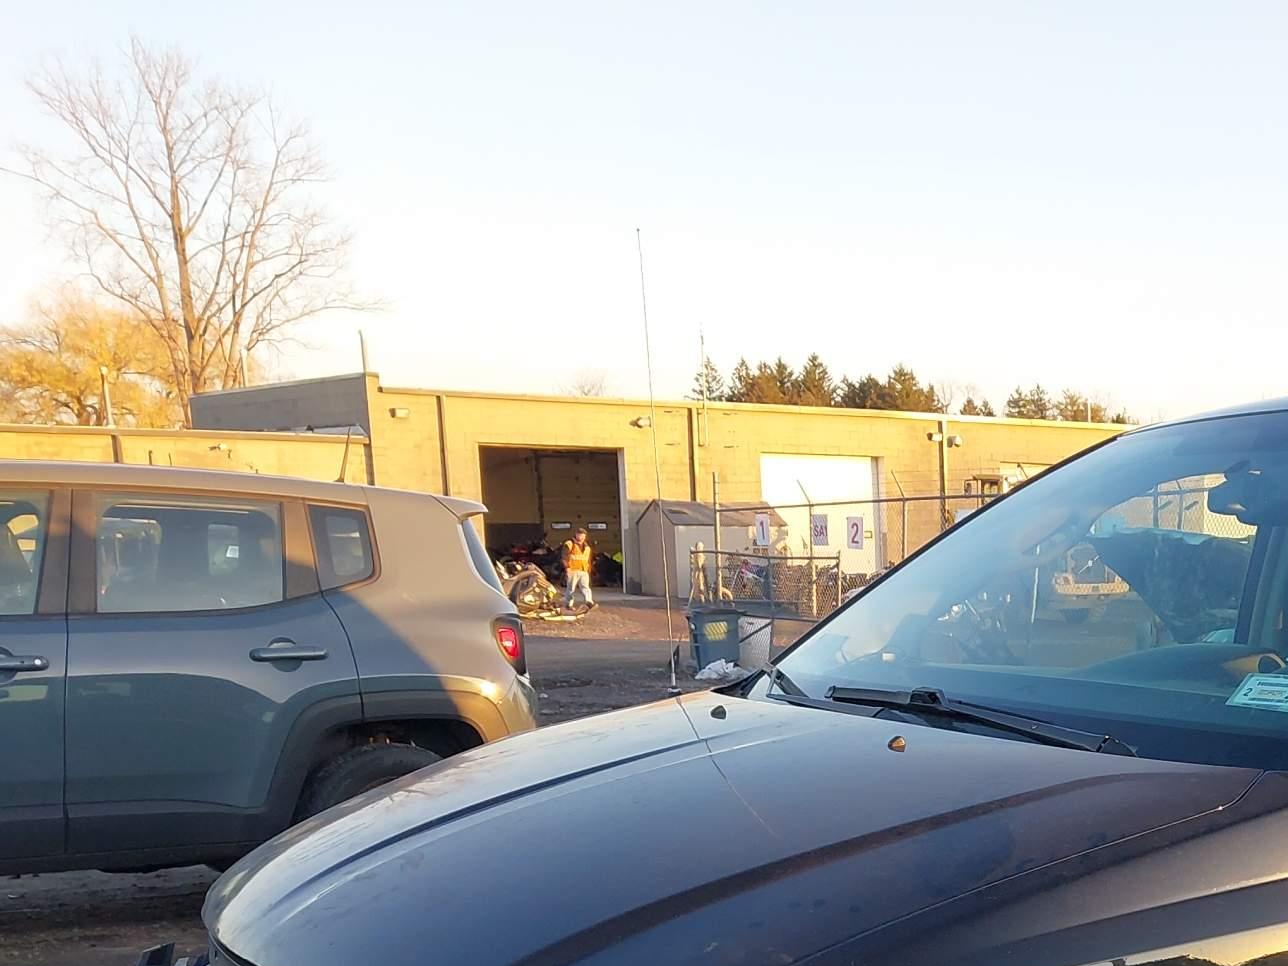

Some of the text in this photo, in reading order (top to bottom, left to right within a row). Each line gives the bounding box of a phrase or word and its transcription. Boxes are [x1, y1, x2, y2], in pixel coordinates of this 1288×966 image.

[759, 520, 766, 540] 1
[850, 522, 860, 545] 2
[1243, 687, 1254, 698] 2
